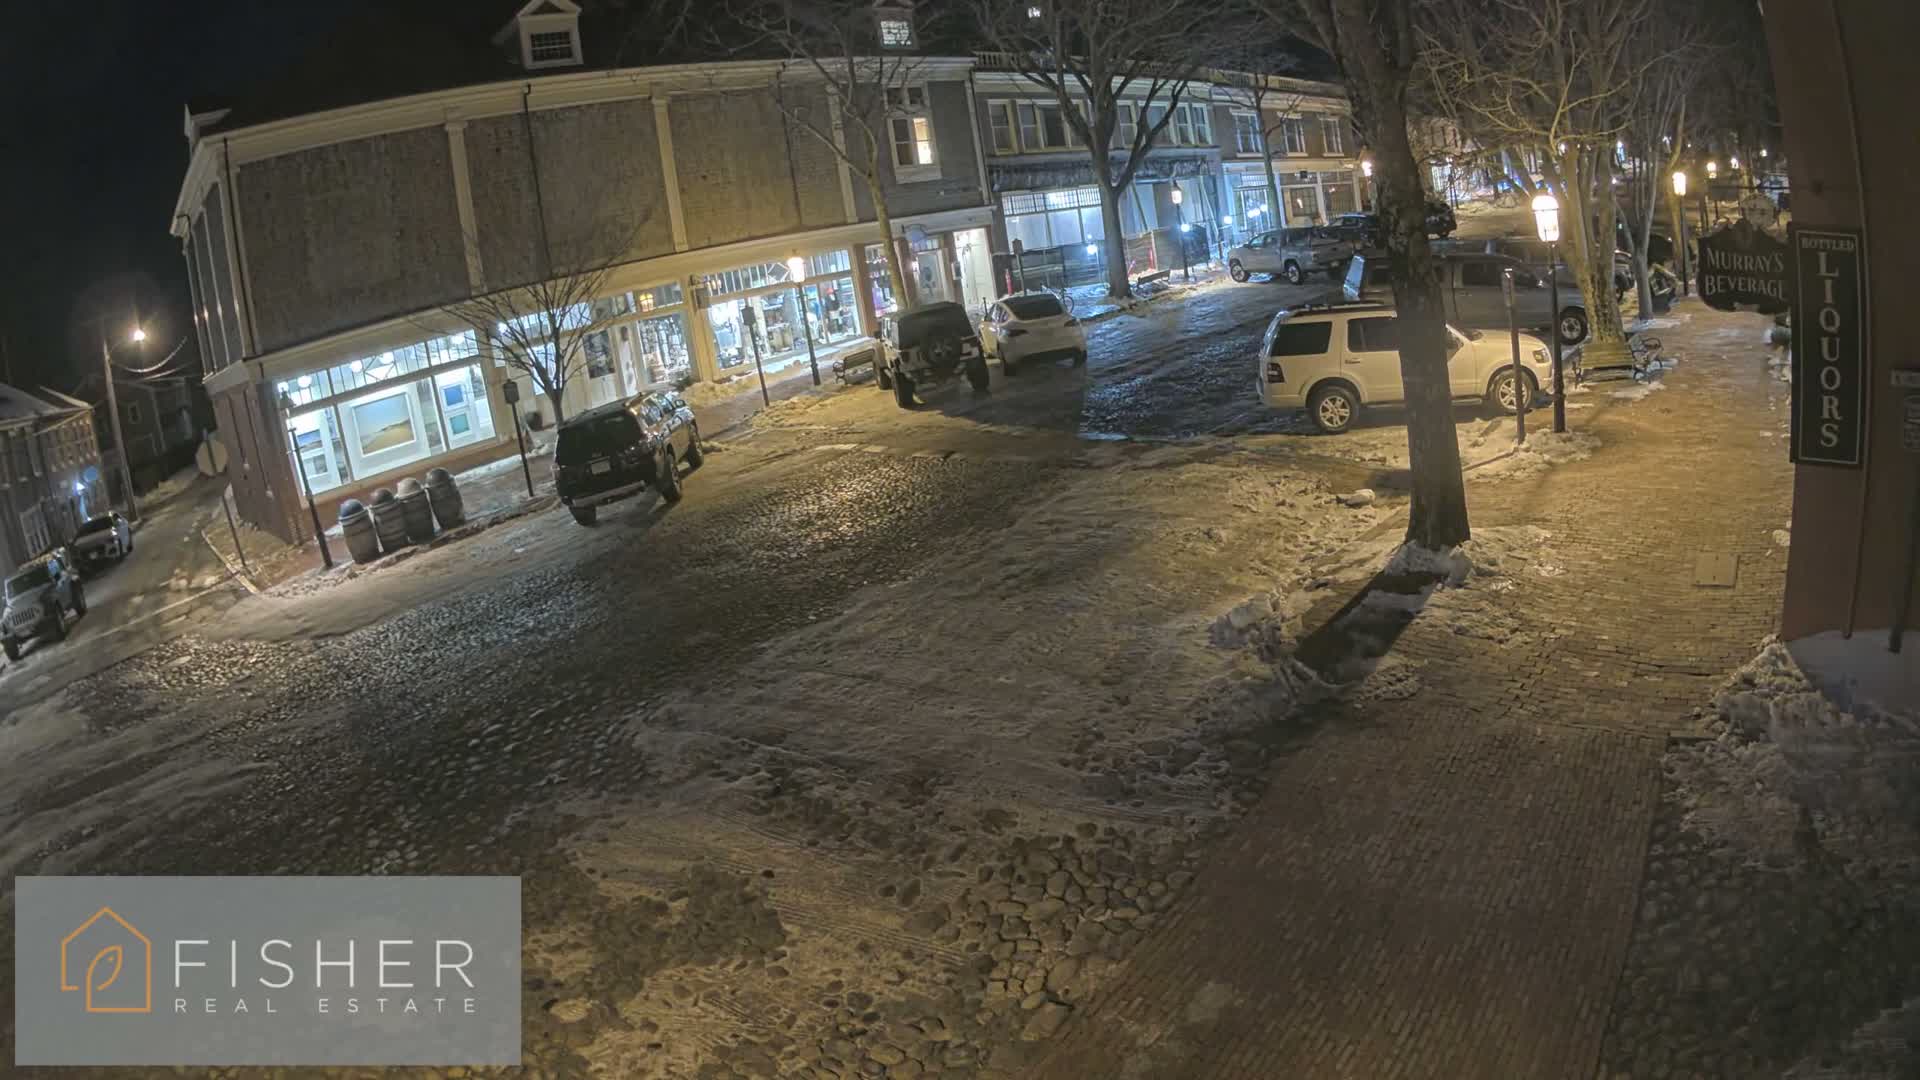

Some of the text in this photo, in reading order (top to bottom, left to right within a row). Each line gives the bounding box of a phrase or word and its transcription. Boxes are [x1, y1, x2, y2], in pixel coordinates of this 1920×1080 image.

[1801, 237, 1855, 251] BOTTLED
[1706, 249, 1784, 273] MURRAY'S
[1816, 252, 1842, 448] LIQUORS
